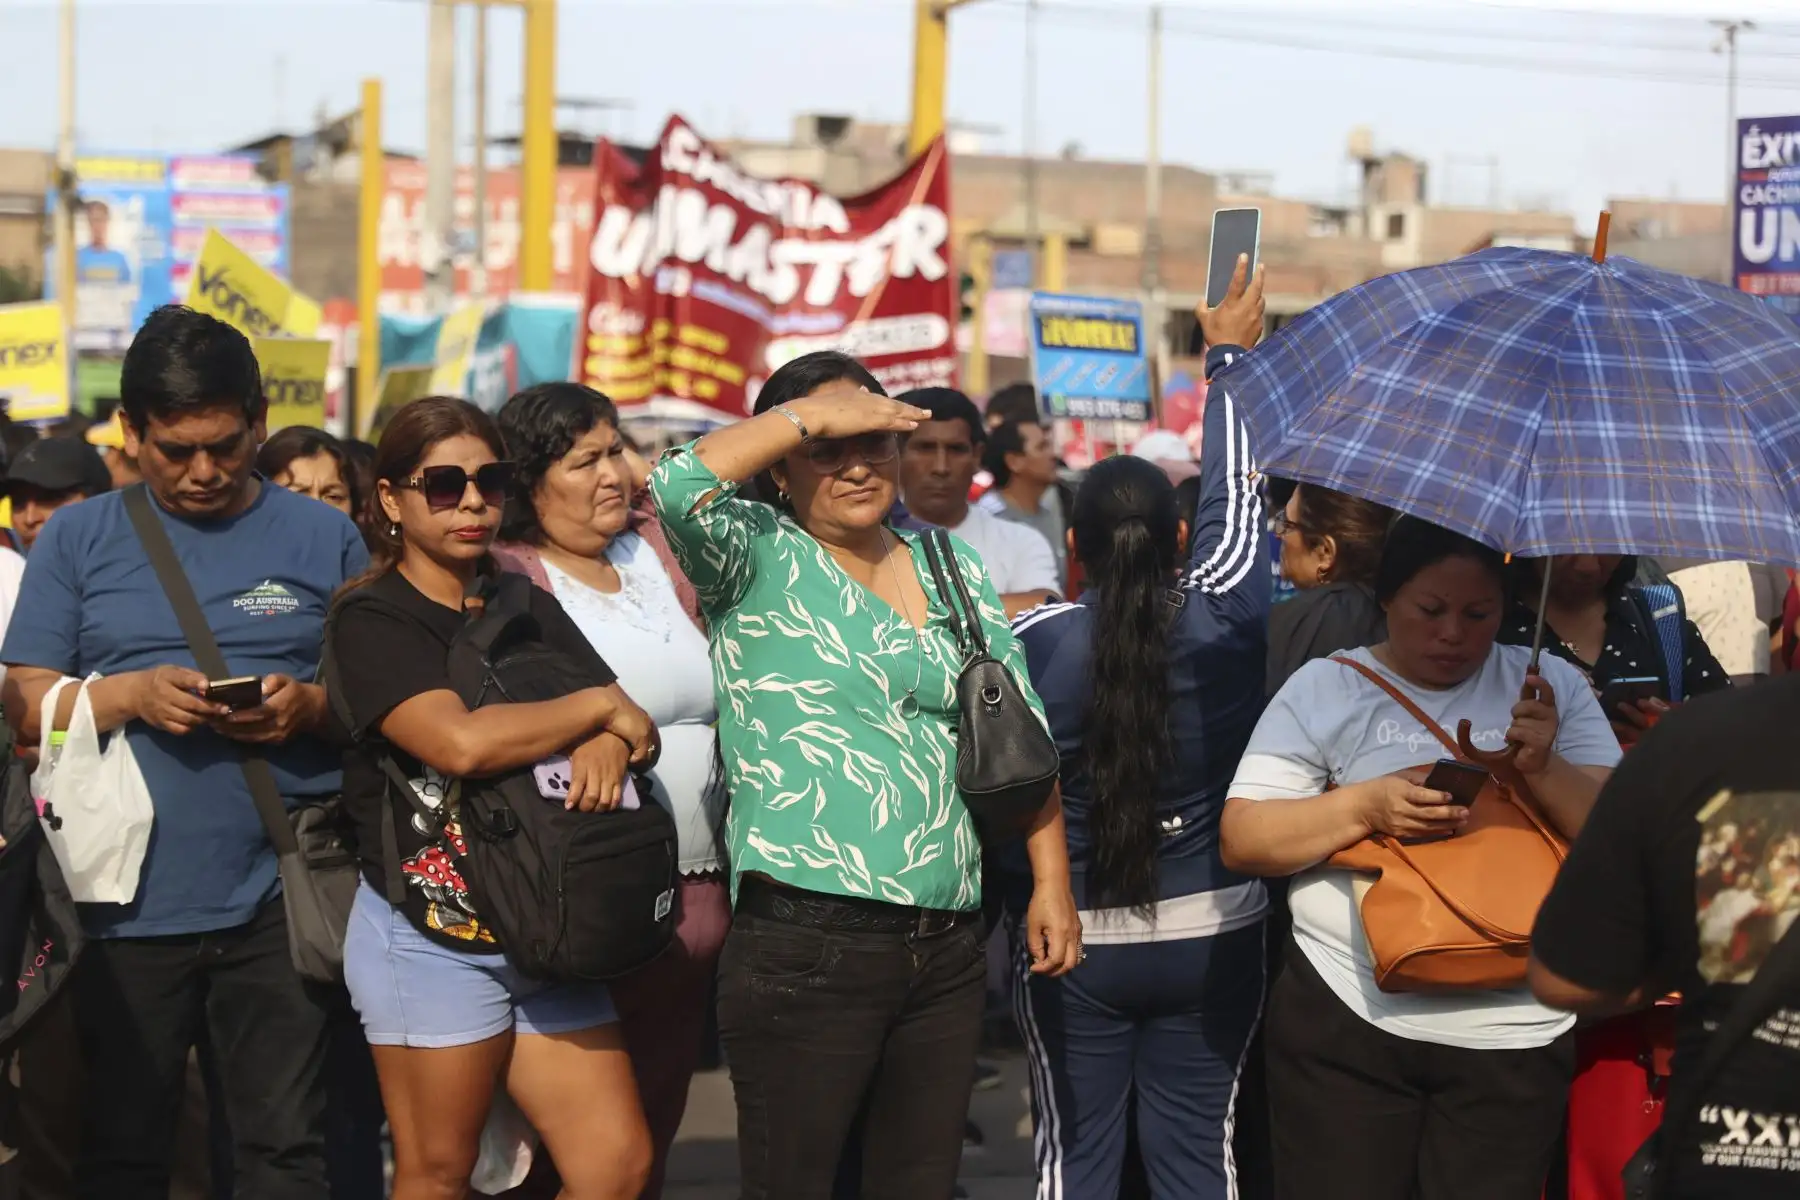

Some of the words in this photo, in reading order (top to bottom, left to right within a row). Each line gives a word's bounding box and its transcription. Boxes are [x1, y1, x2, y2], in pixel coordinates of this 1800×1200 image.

[233, 598, 254, 607] DOO
[256, 597, 300, 606] AUSTRALIA
[16, 939, 54, 993] AVON
[1743, 1157, 1779, 1170] TEARS
